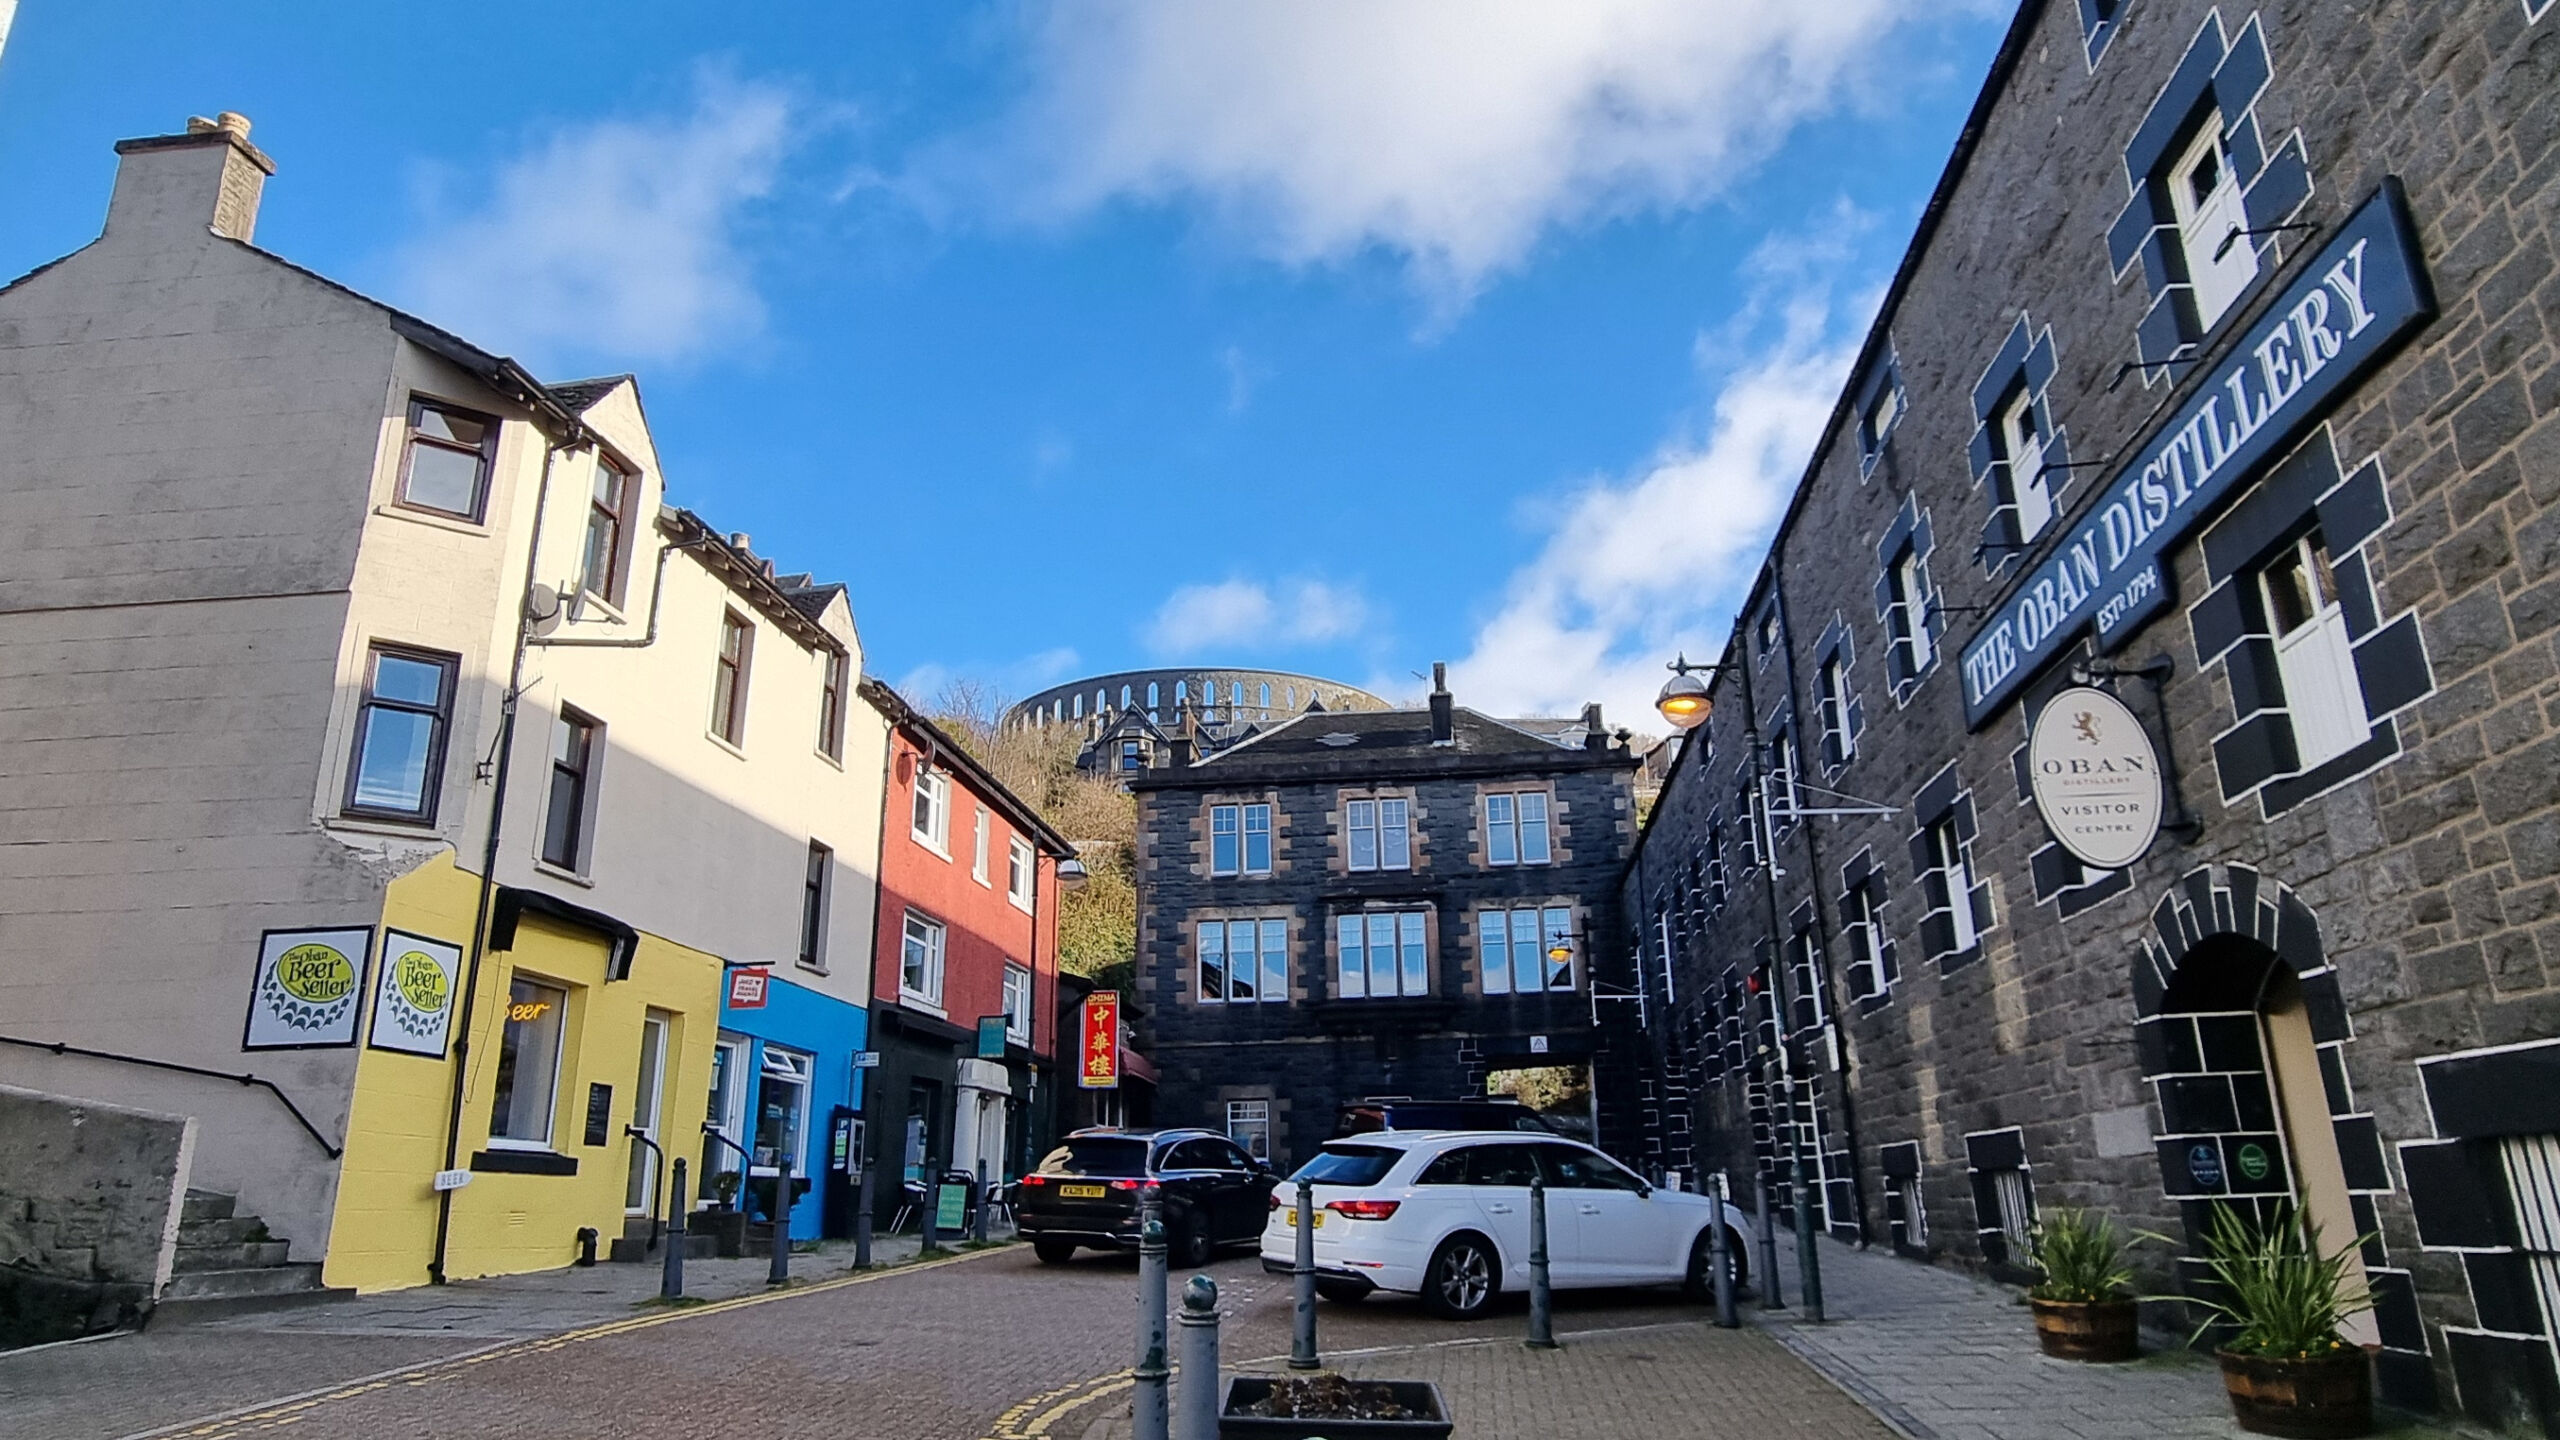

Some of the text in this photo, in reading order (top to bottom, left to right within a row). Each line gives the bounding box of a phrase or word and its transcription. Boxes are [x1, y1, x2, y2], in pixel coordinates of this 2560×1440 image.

[1966, 238, 2376, 706] THE OBAN DISTILLERY
[2126, 571, 2157, 608] 1794
[2043, 756, 2144, 775] OBAN
[2062, 777, 2131, 786] DISTILLERY
[2061, 803, 2140, 816] VISITOR
[2074, 824, 2134, 834] CENTRE
[288, 958, 342, 983] Beer
[404, 966, 442, 990] Beer
[300, 977, 351, 998] Seller
[411, 987, 447, 1008] Seller
